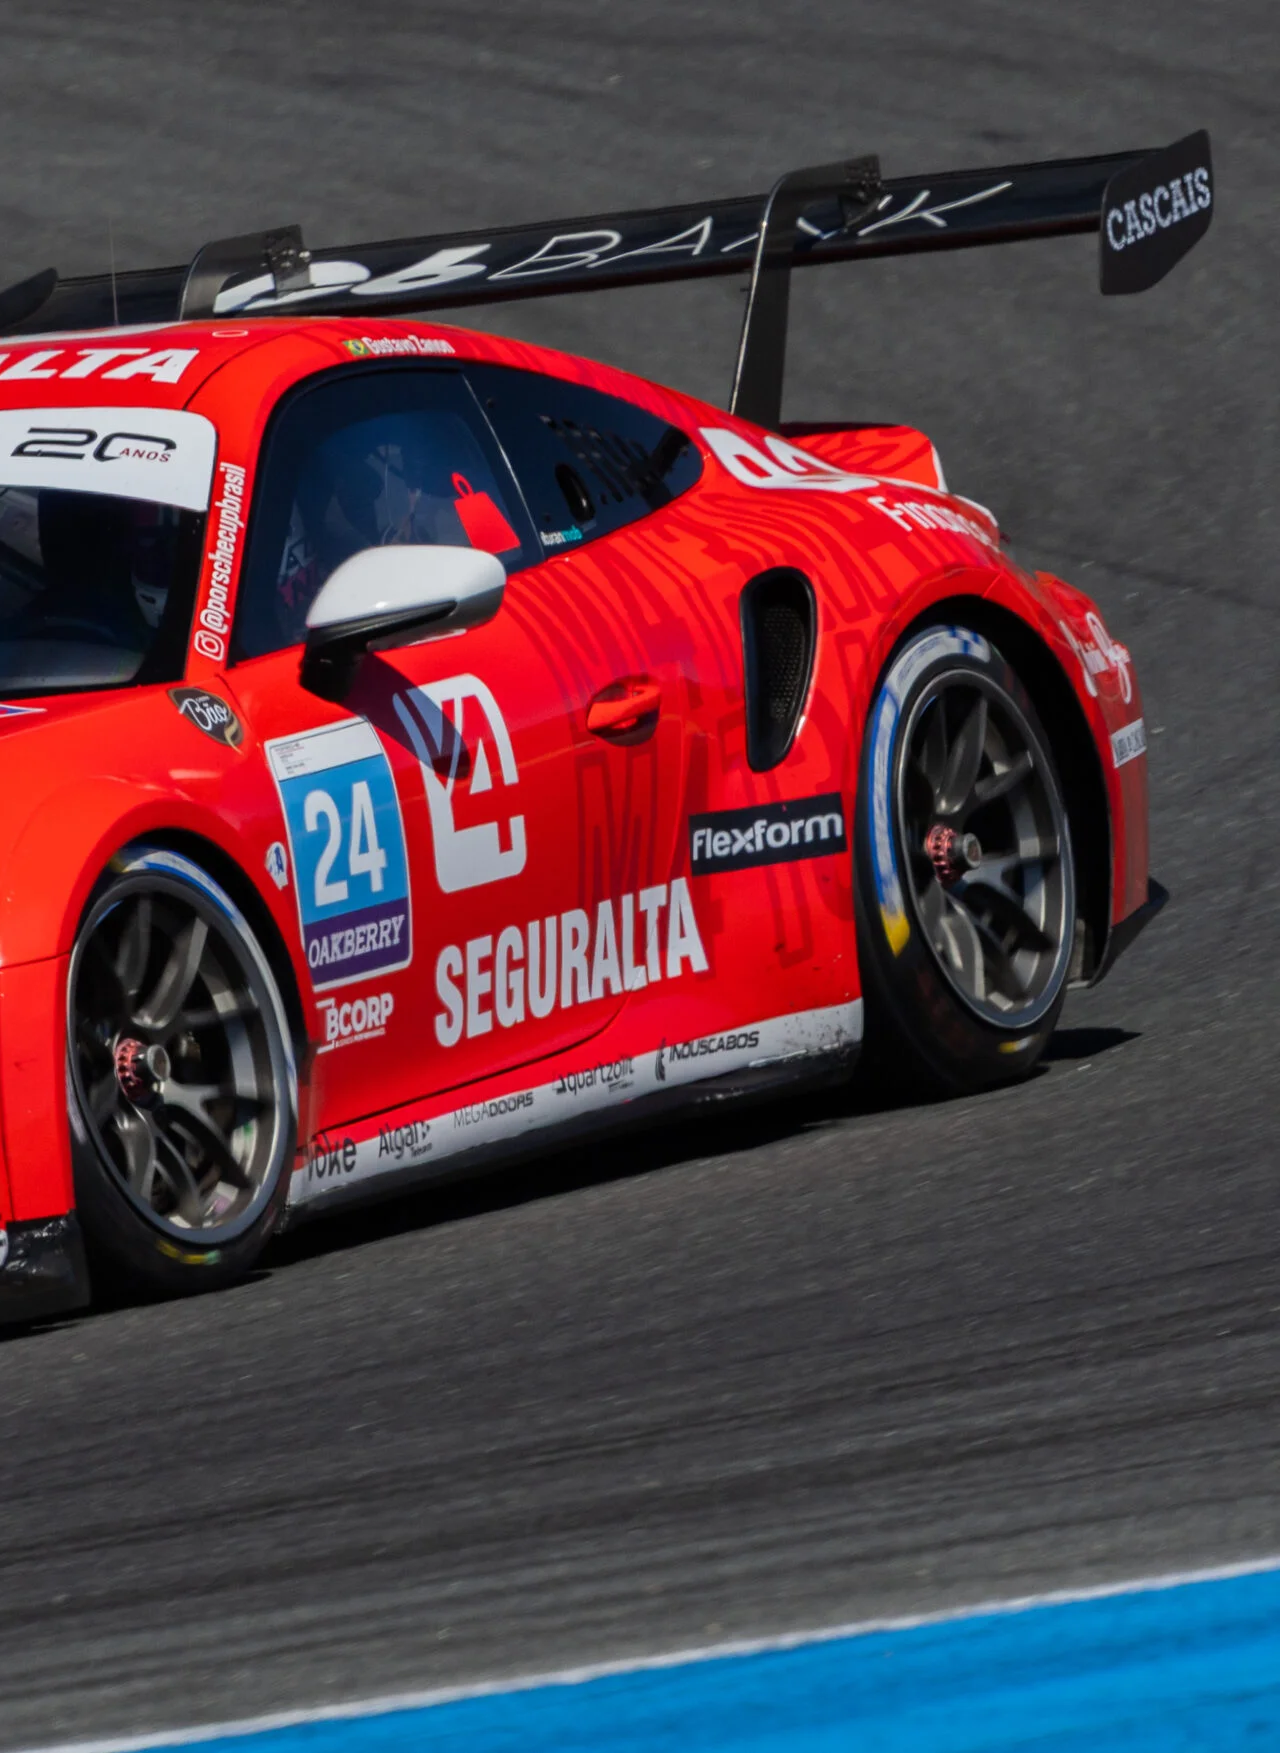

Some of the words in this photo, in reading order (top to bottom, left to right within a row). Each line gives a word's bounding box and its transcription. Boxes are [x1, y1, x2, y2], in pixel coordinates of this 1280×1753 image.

[1107, 167, 1211, 250] CASCAIS
[120, 447, 170, 463] ANOS
[200, 462, 246, 634] @porschecupbrasil
[304, 780, 388, 907] 24
[692, 812, 843, 861] Flexform
[308, 914, 405, 968] OAKBERRY
[434, 877, 709, 1049] SEGURALTA
[326, 992, 394, 1041] BCORP
